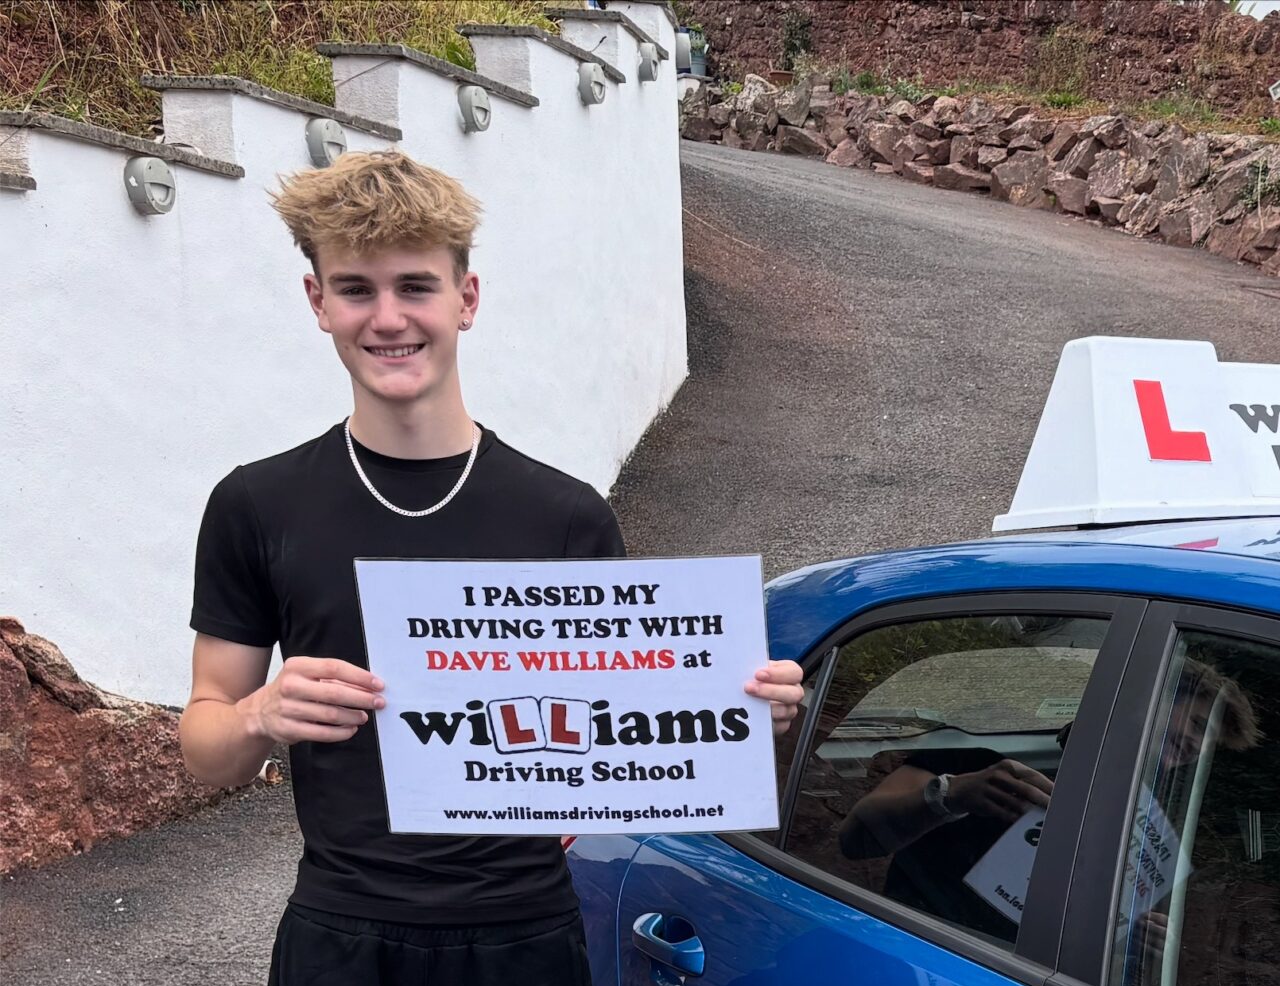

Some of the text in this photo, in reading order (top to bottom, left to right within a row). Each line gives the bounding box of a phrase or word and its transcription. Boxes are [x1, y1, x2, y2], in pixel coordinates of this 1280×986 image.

[1132, 379, 1212, 463] L
[462, 584, 660, 607] I PASSED MY
[407, 614, 724, 639] DRIVING TEST WITH
[426, 648, 712, 672] DAVE WILLIAMS at
[464, 759, 696, 787] Driving School
[443, 804, 725, 823] www.williamsdrivingschool.net
